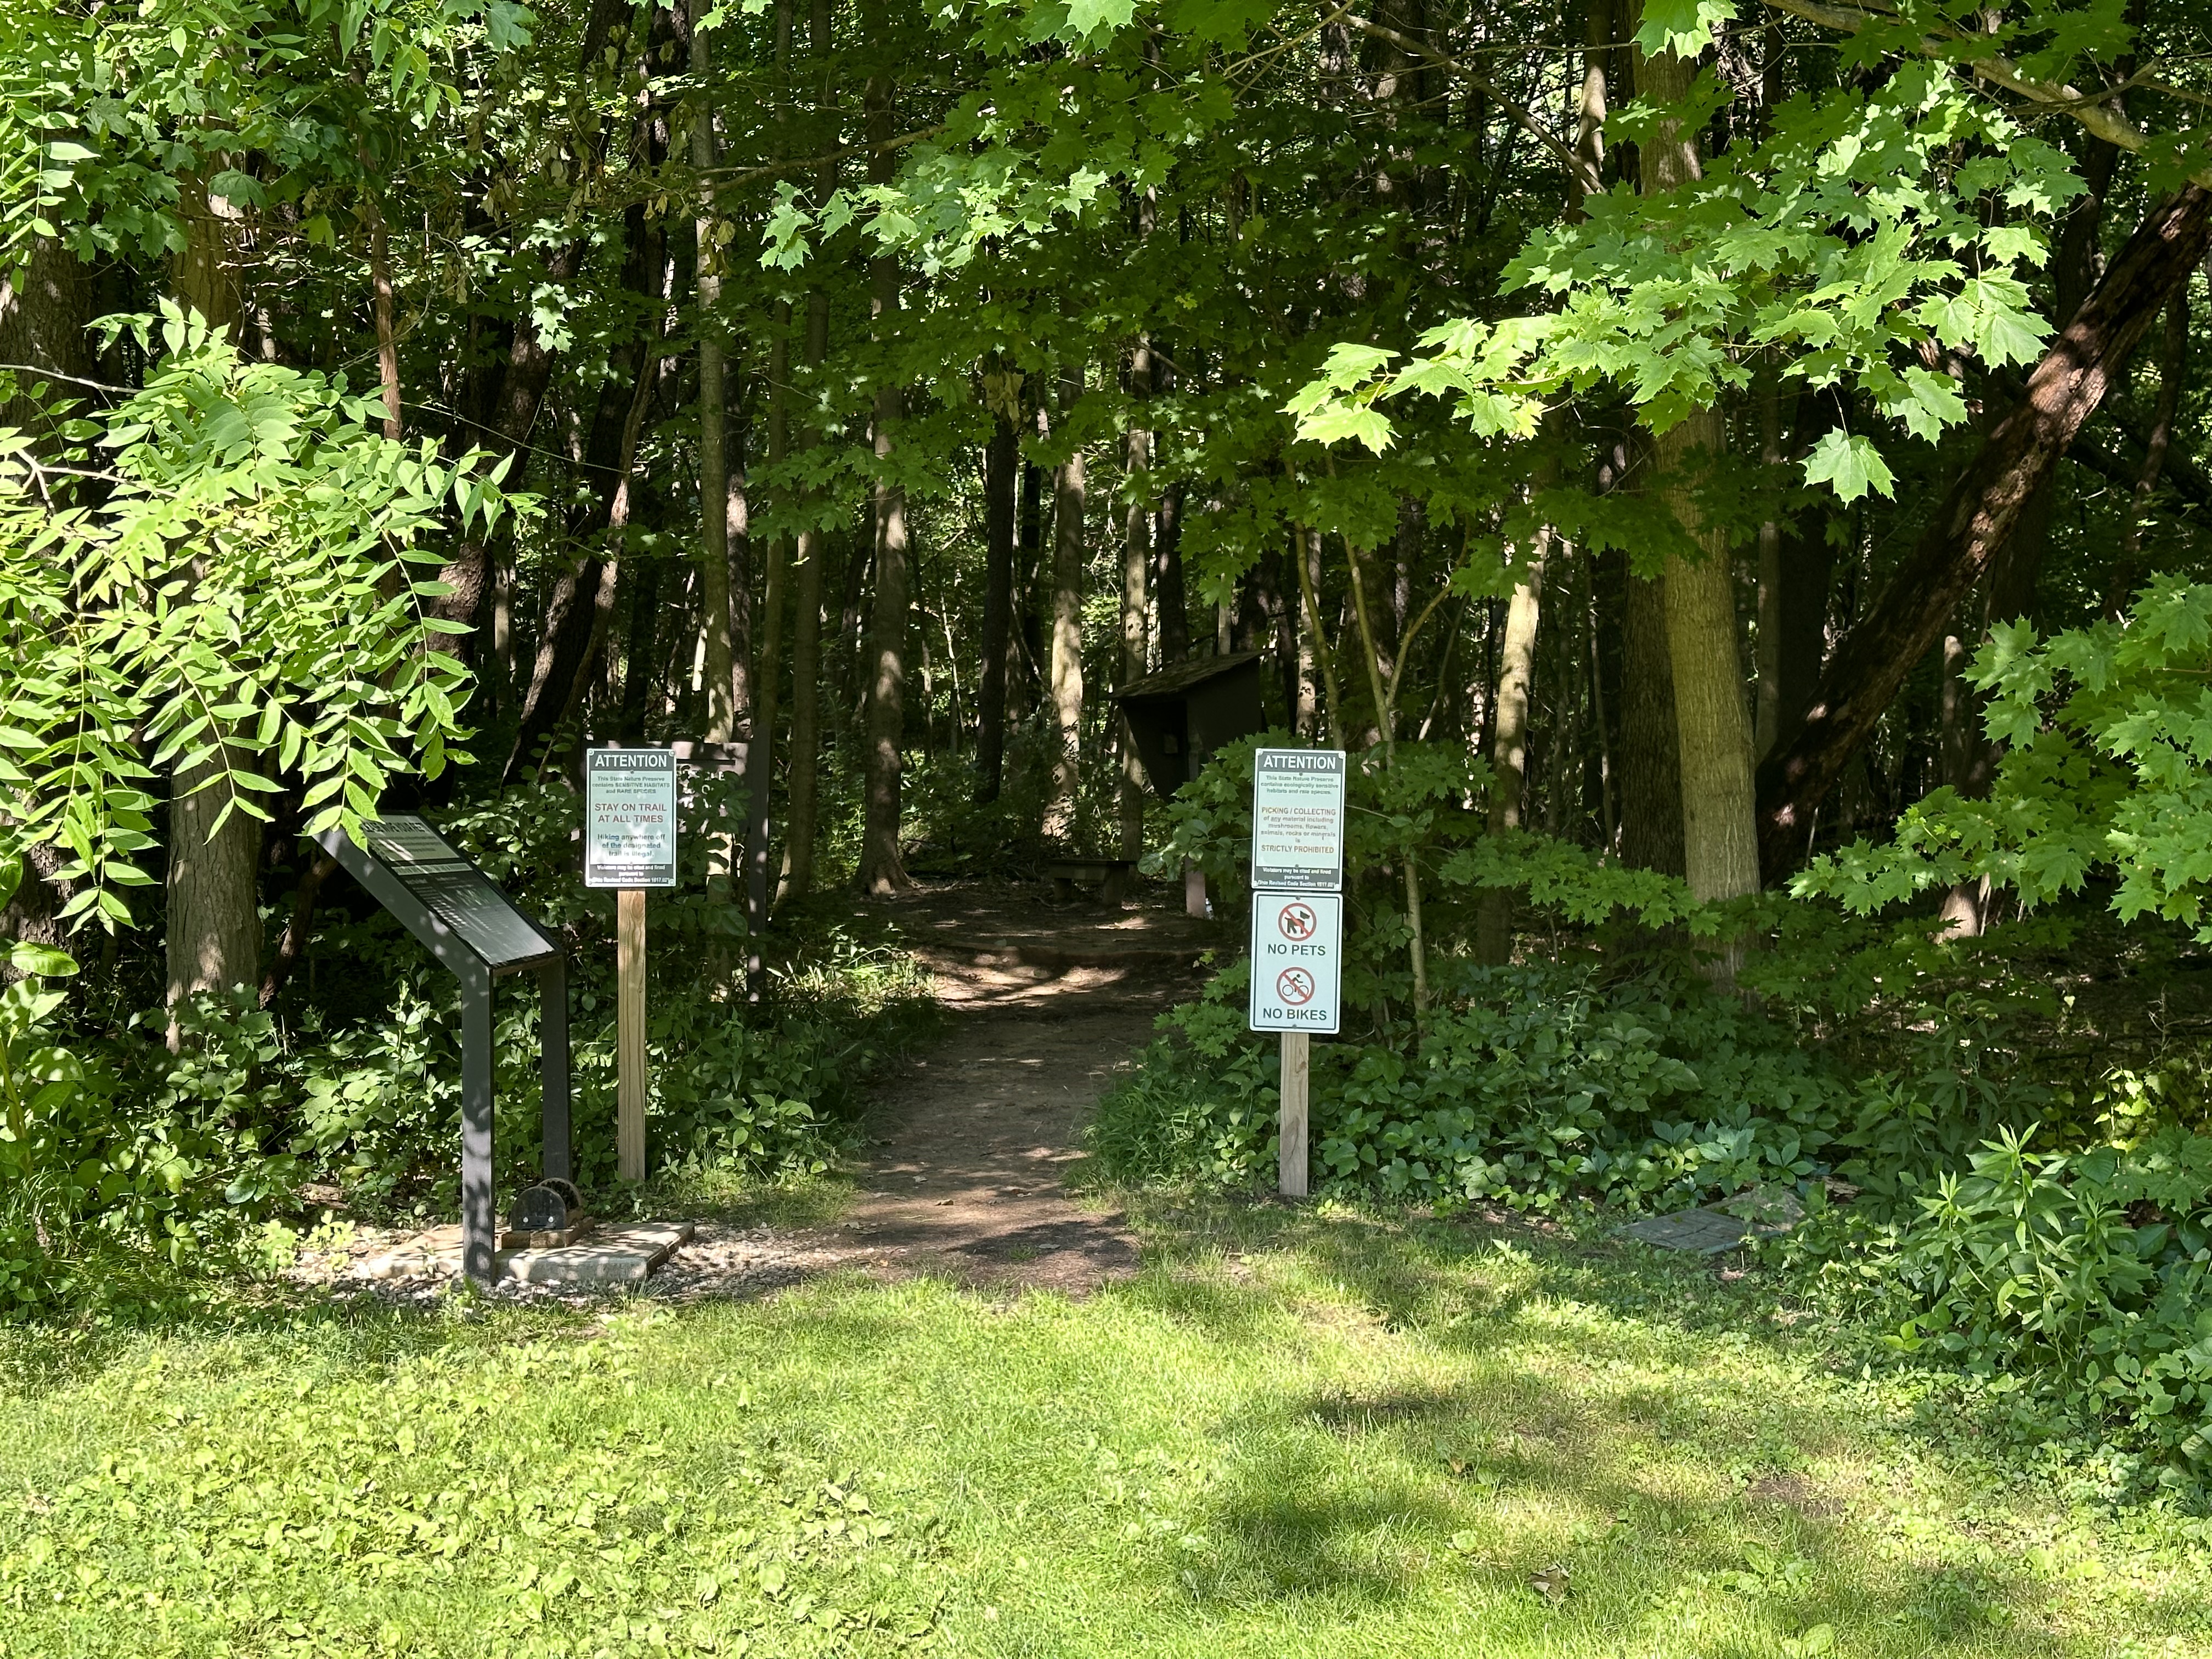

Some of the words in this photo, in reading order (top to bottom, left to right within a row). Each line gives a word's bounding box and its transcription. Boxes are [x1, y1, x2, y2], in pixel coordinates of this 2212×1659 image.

[595, 754, 667, 767] ATTENTION
[1263, 755, 1336, 770] ATTENTION
[639, 803, 667, 811] TRAIL
[1268, 944, 1287, 955] NO
[1291, 945, 1326, 956] PETS
[1263, 1008, 1283, 1018] NO
[1287, 1009, 1327, 1020] BIKES
